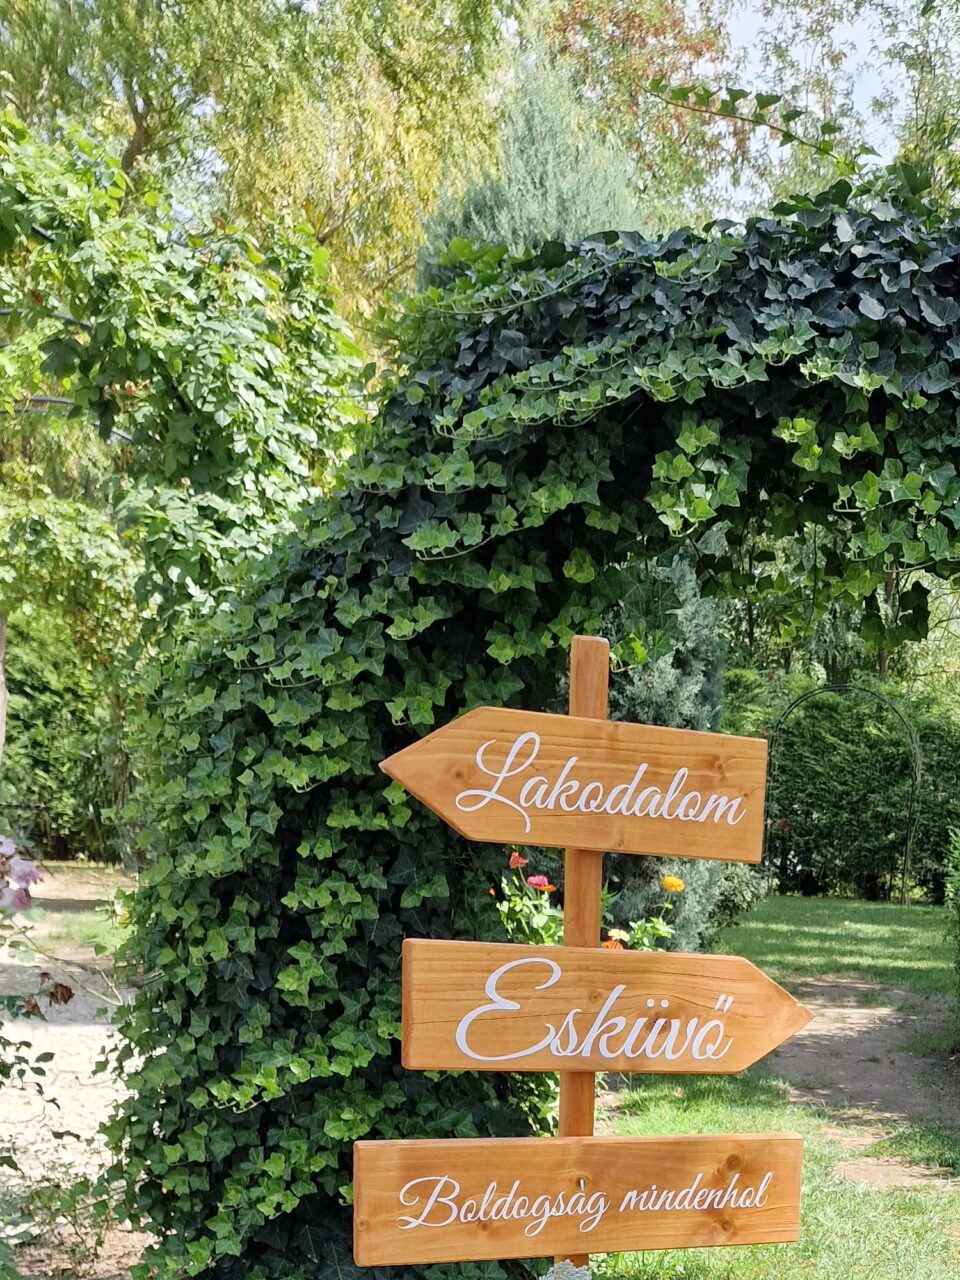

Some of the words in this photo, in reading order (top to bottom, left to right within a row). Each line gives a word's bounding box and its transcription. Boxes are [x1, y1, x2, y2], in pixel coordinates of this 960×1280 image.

[455, 732, 746, 833] Lakodalom
[455, 957, 734, 1061] Esküvő
[618, 1172, 772, 1213] mindenhol
